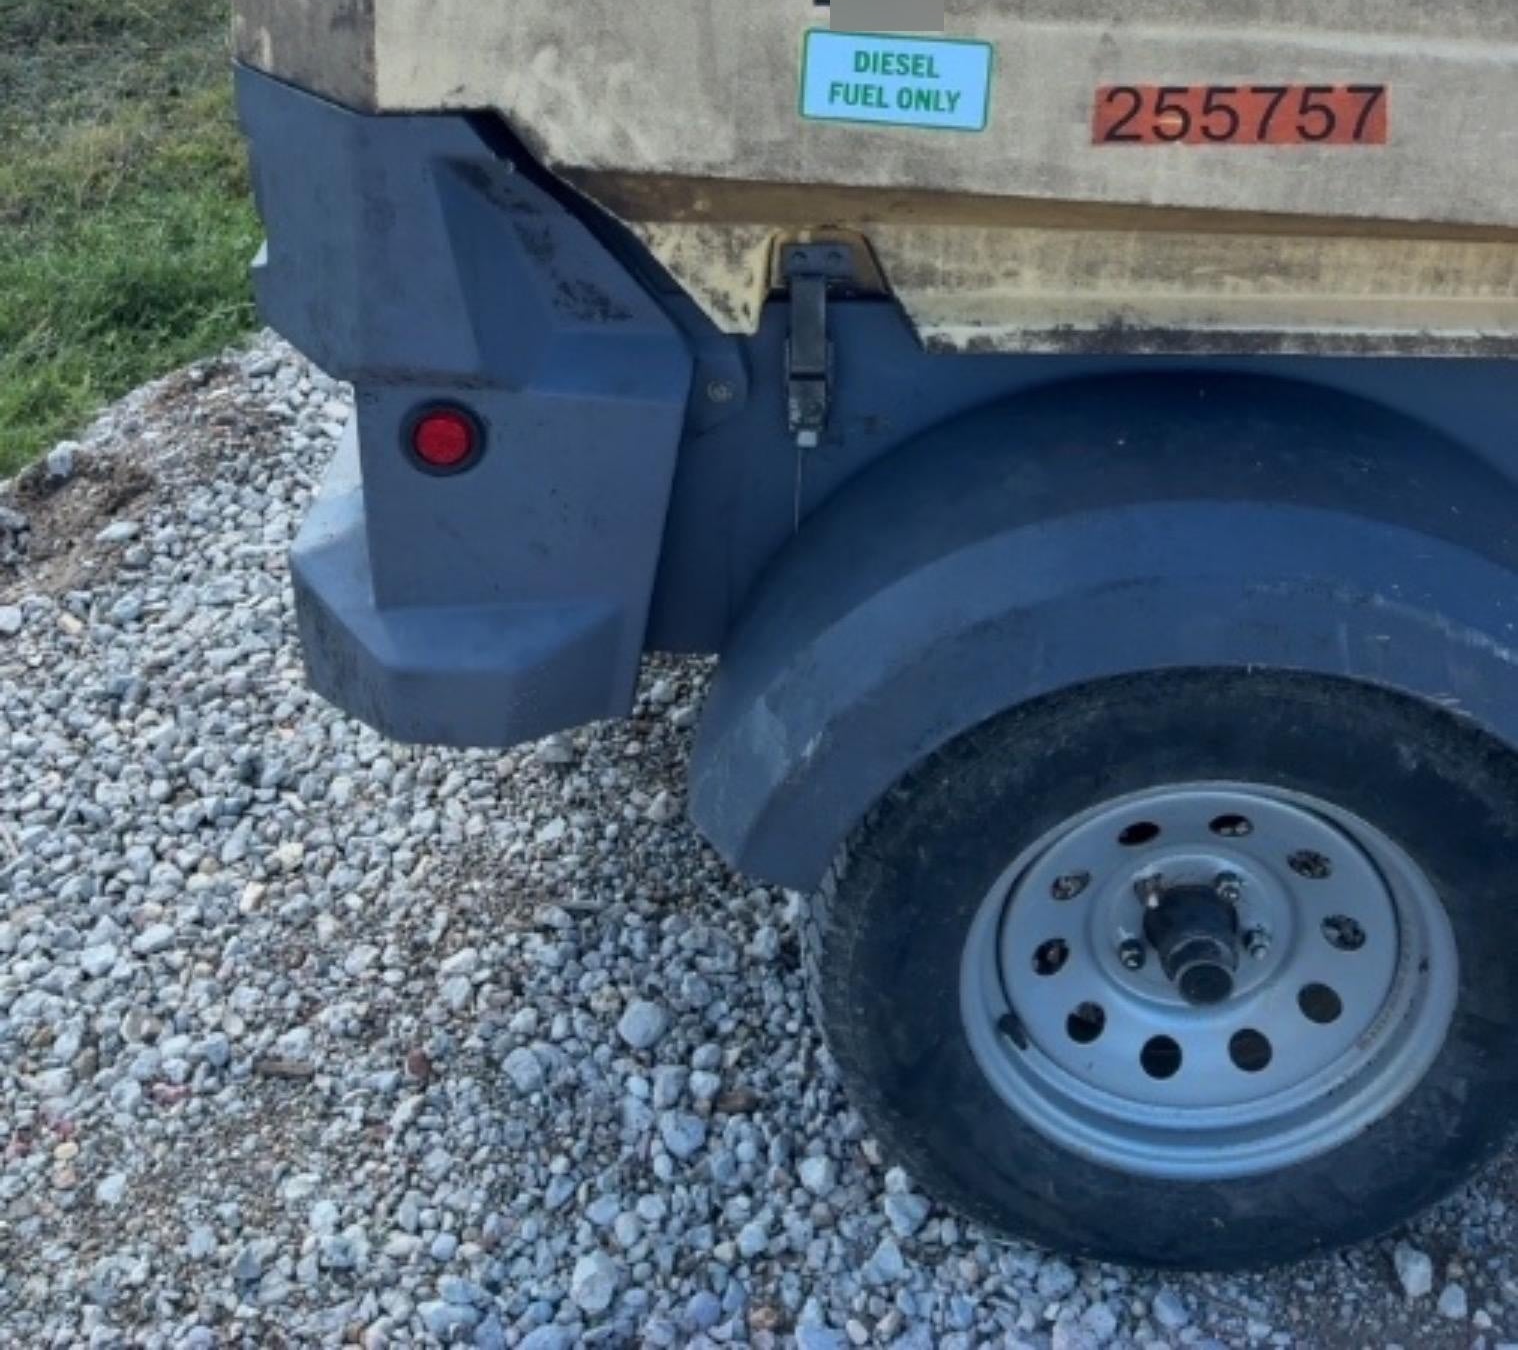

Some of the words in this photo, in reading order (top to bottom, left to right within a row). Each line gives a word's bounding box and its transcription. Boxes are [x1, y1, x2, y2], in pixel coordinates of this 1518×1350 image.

[854, 51, 941, 78] DIESEL
[828, 82, 889, 108] FUEL
[896, 87, 961, 113] ONLY
[1103, 85, 1385, 143] 255757
